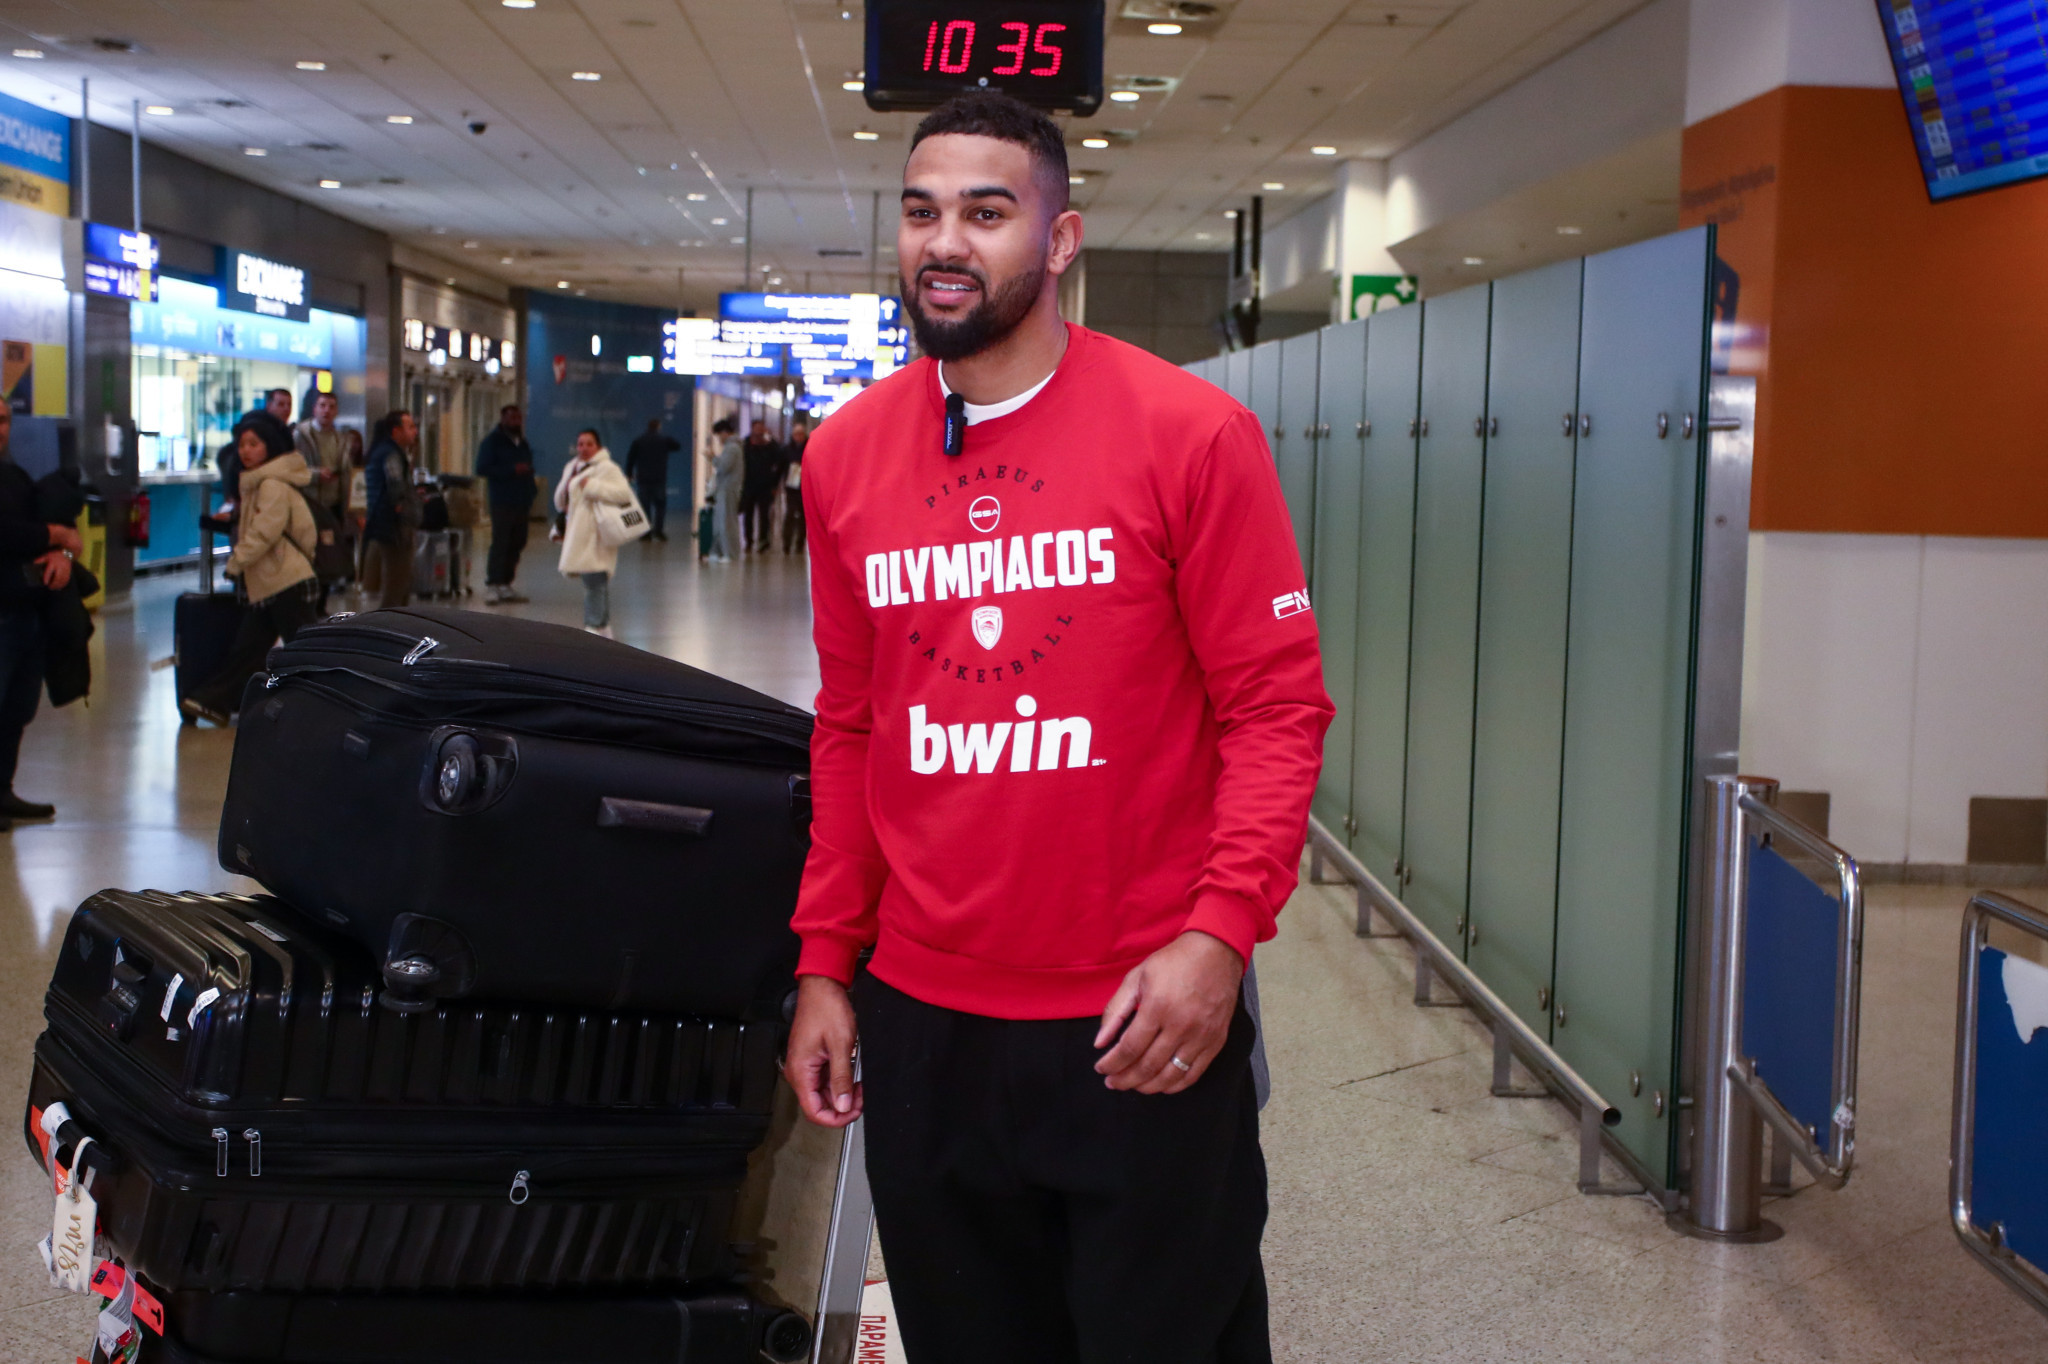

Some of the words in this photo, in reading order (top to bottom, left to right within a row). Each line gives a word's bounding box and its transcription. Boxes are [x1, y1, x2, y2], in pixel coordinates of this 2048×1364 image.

[922, 19, 976, 74] 10
[992, 21, 1067, 77] 35
[237, 253, 304, 305] EXCHANGE
[925, 465, 1045, 509] PIRAEUS
[971, 508, 999, 519] GSA
[865, 527, 1116, 608] OLYMPIACOS
[908, 614, 1073, 683] BASKETBALL
[908, 695, 1092, 775] bwin
